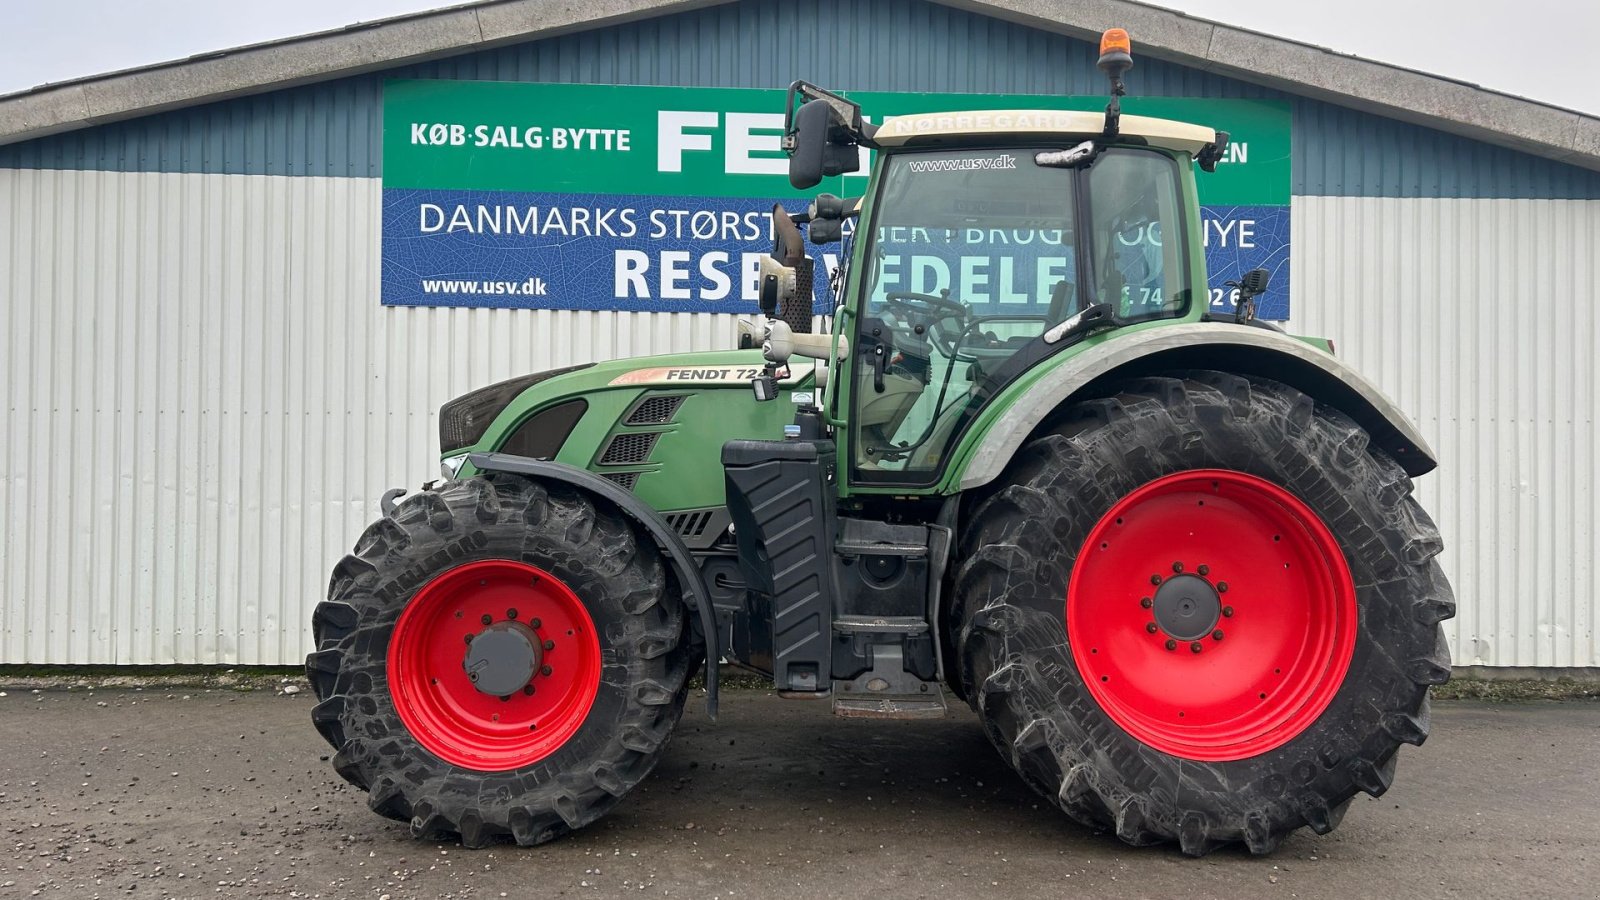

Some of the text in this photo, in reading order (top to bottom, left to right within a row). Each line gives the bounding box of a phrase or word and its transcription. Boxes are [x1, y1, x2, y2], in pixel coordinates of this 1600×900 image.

[910, 154, 1016, 172] www.usv.dk
[420, 203, 638, 237] DANMARKS
[422, 277, 547, 296] www.usv.dk
[666, 369, 731, 381] FENDT
